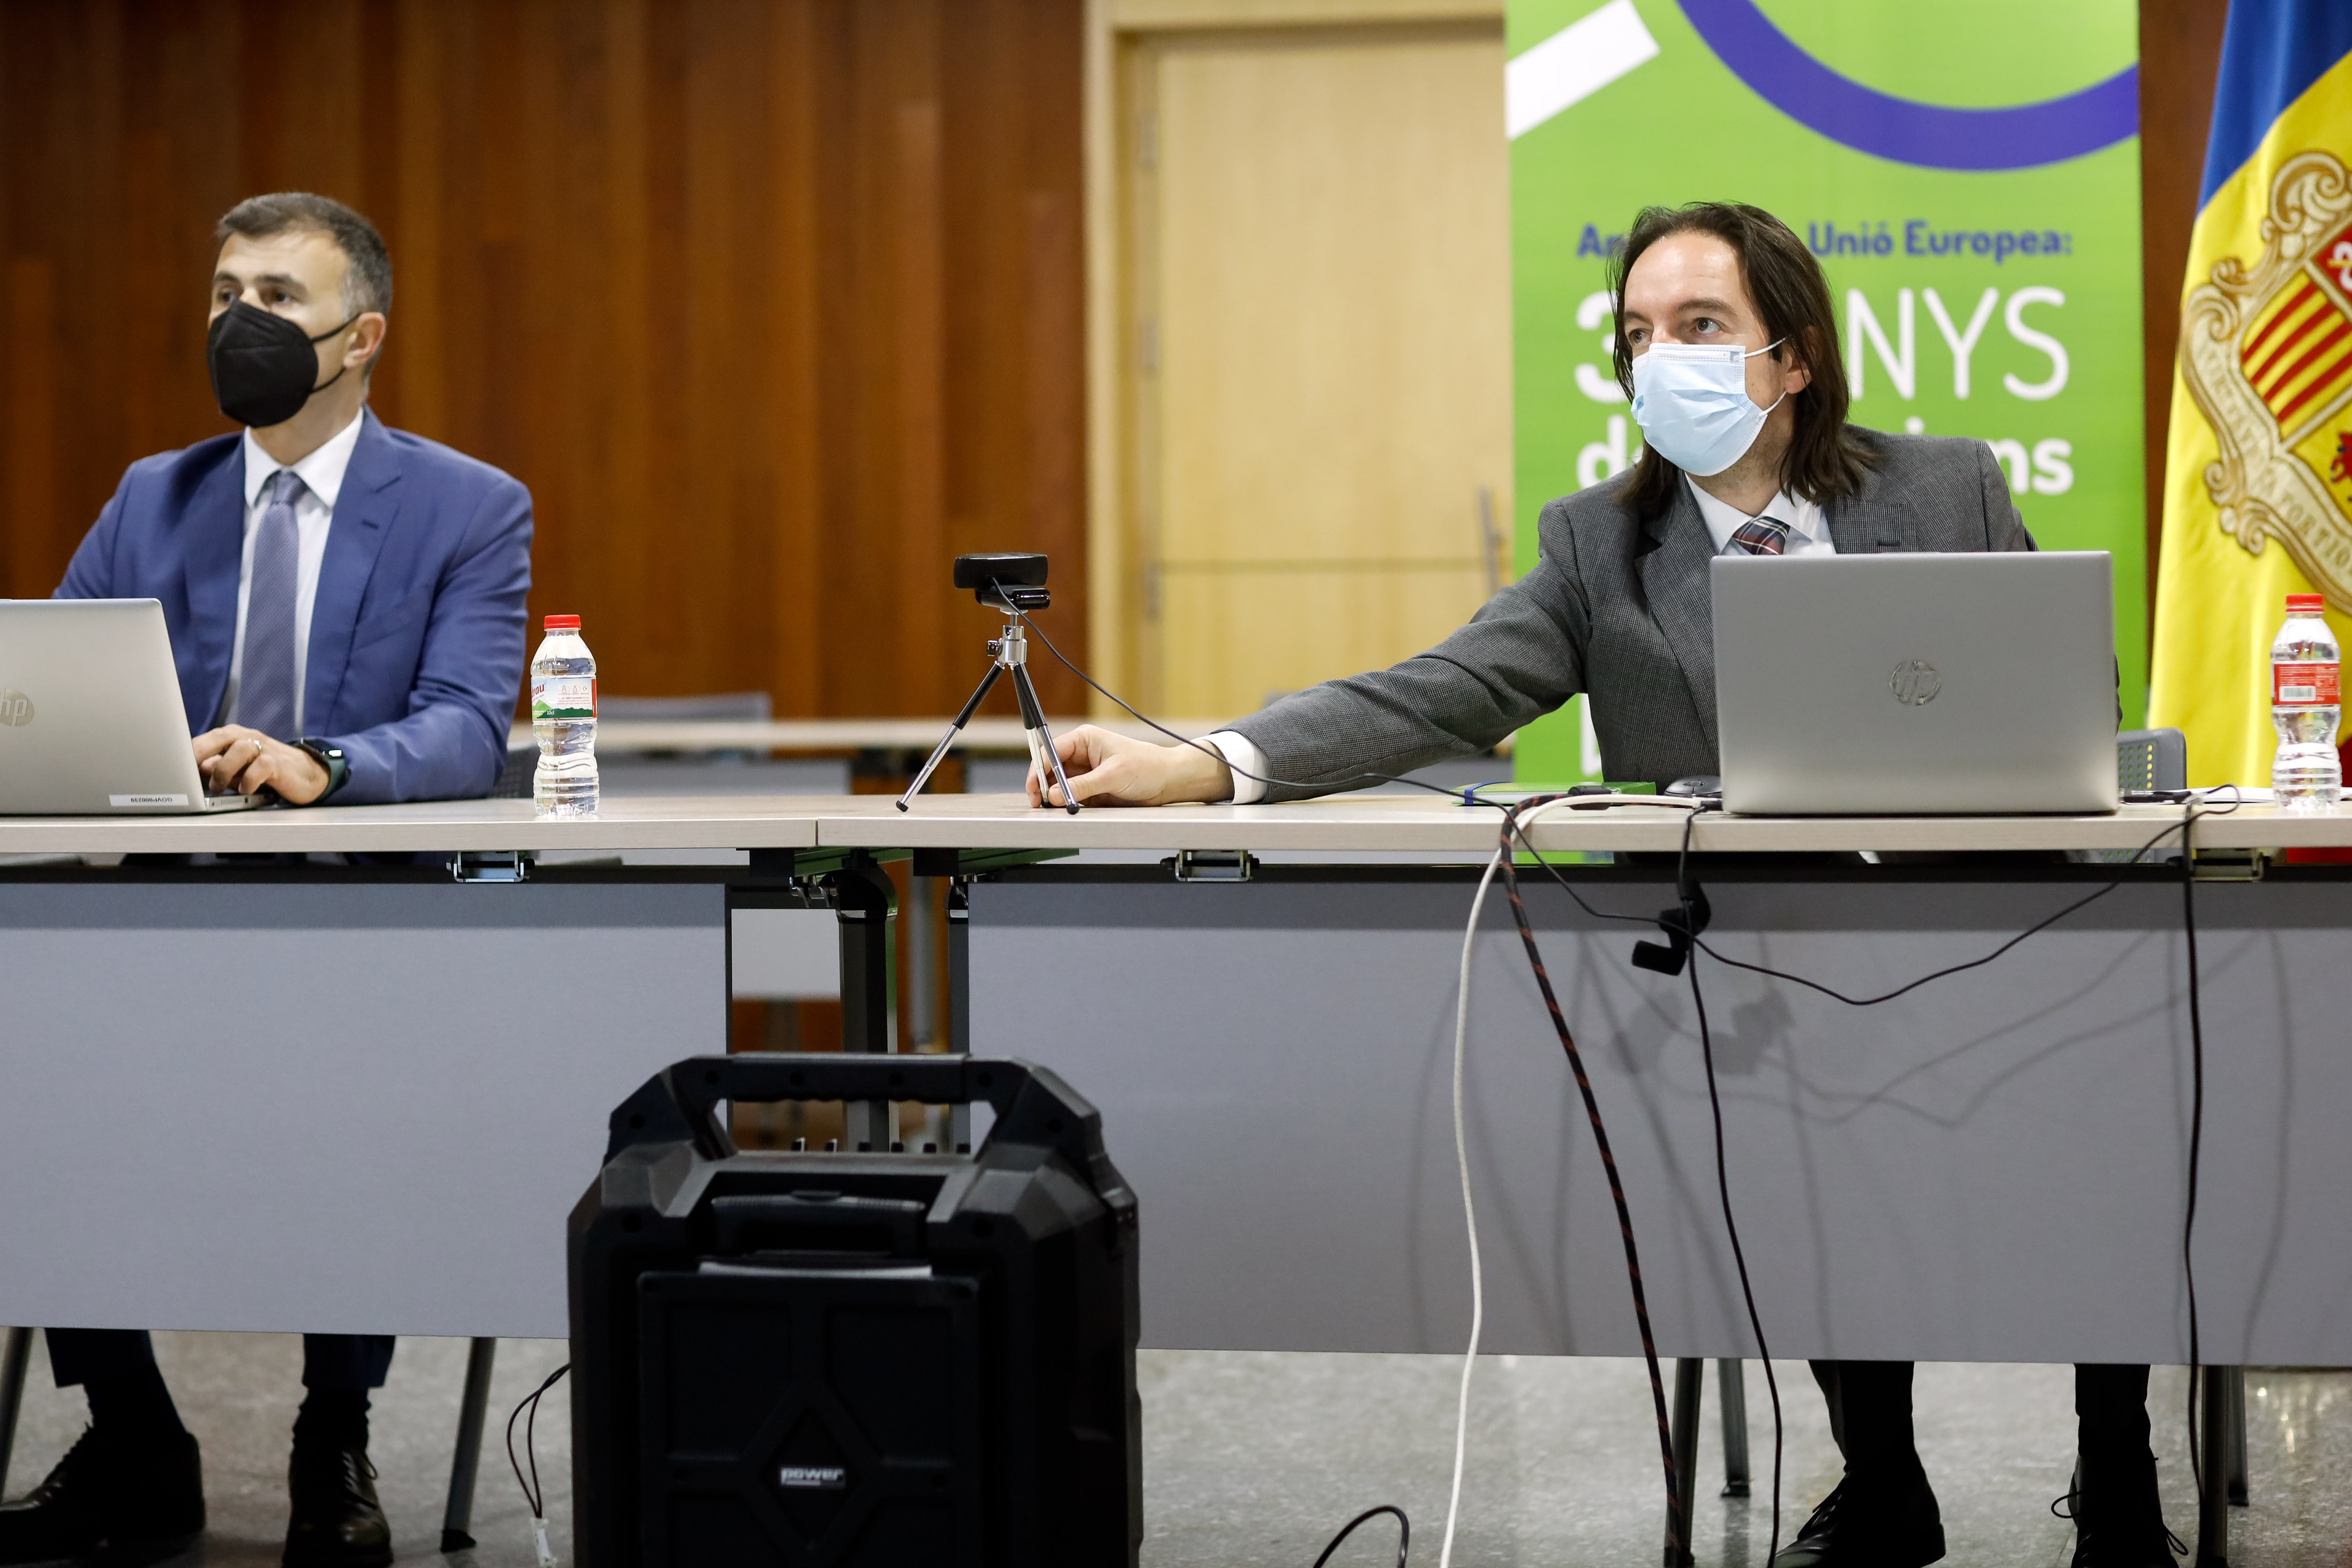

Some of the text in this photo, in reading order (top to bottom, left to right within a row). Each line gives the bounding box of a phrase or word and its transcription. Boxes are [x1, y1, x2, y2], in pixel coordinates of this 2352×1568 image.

[1807, 219, 2072, 264] Unió Europea:
[1846, 287, 2070, 401] NYS
